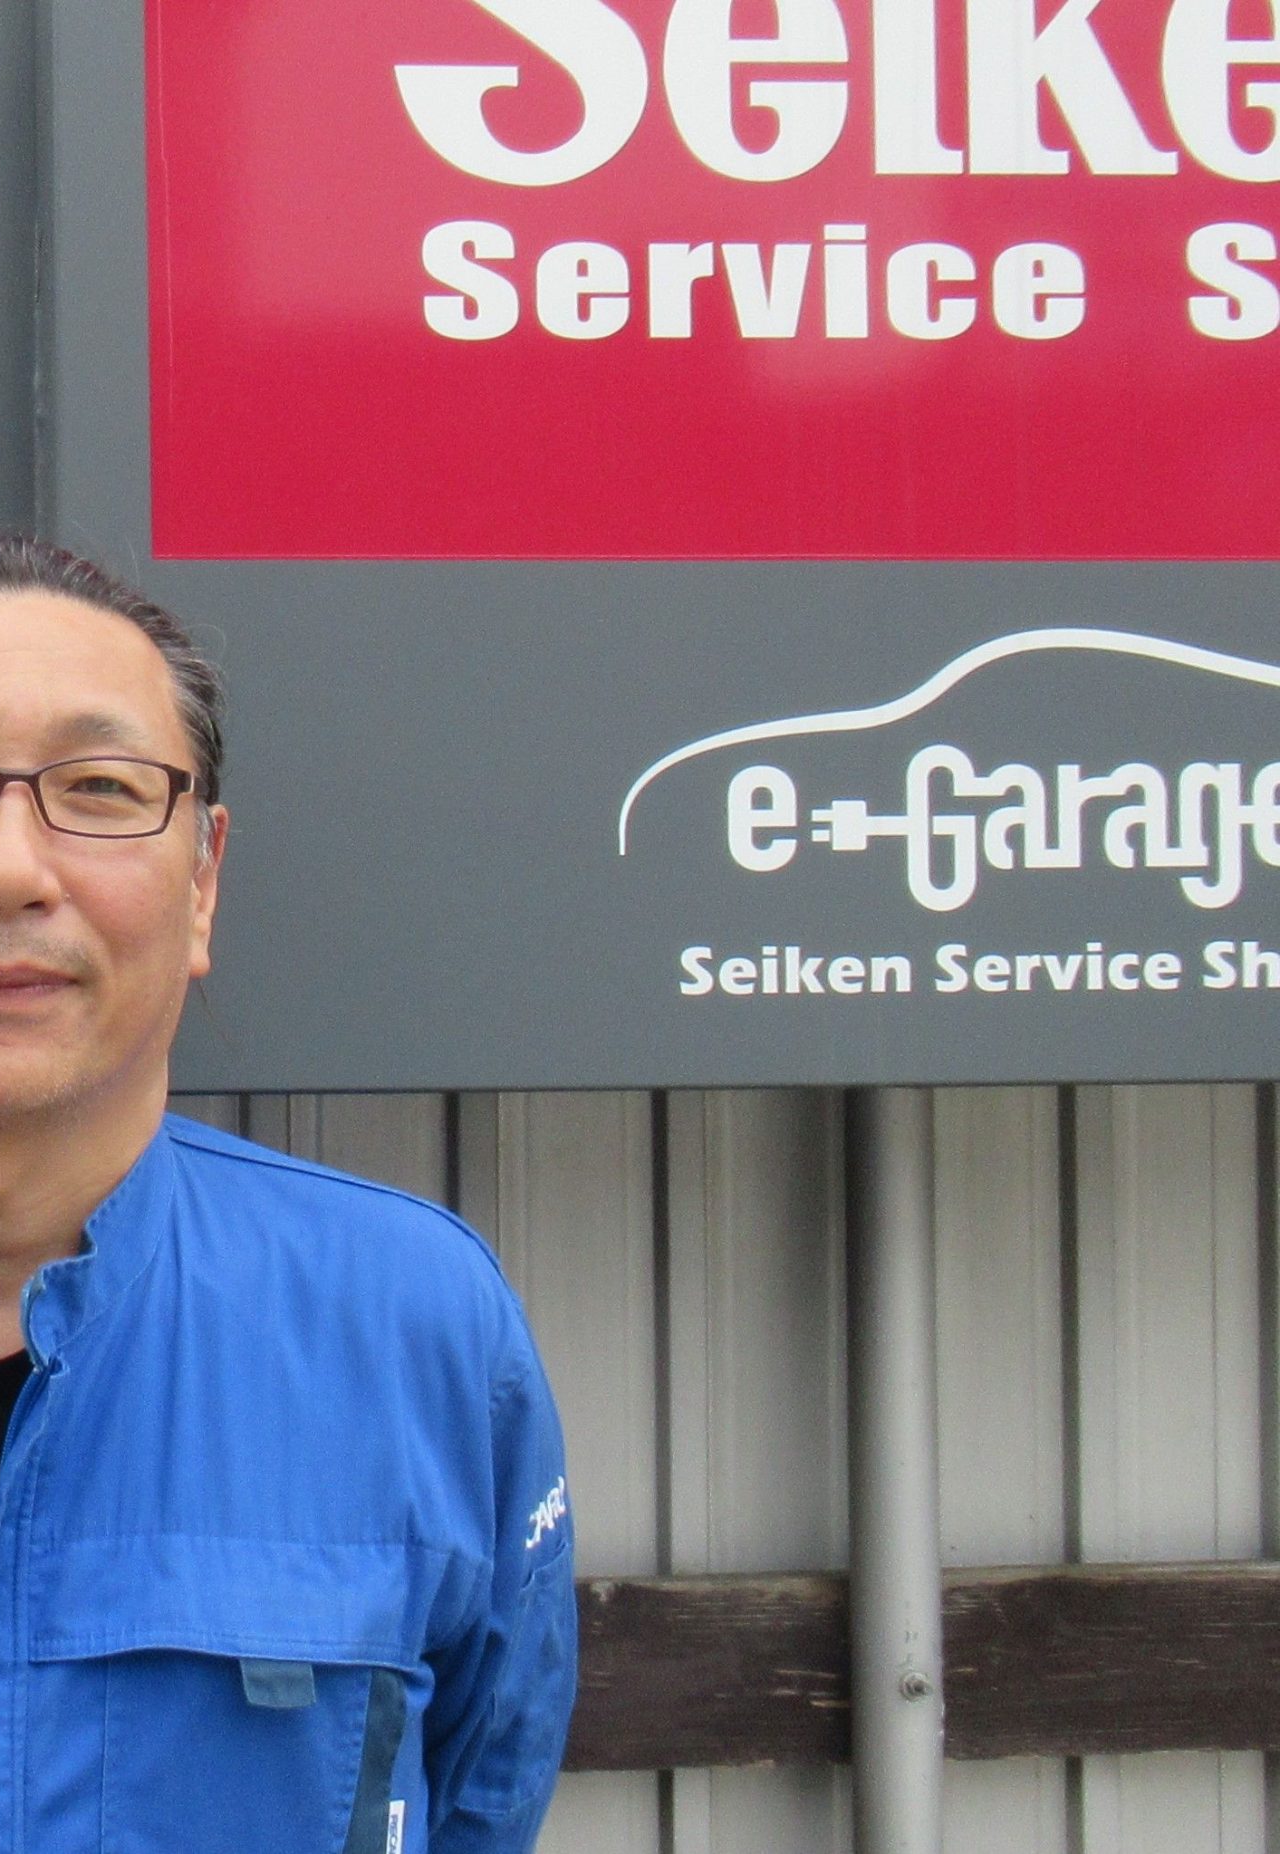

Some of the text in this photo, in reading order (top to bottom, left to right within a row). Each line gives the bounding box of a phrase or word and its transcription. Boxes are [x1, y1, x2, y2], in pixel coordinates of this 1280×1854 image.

[421, 220, 1280, 340] Service S
[679, 940, 1280, 996] Seiken Service Sh
